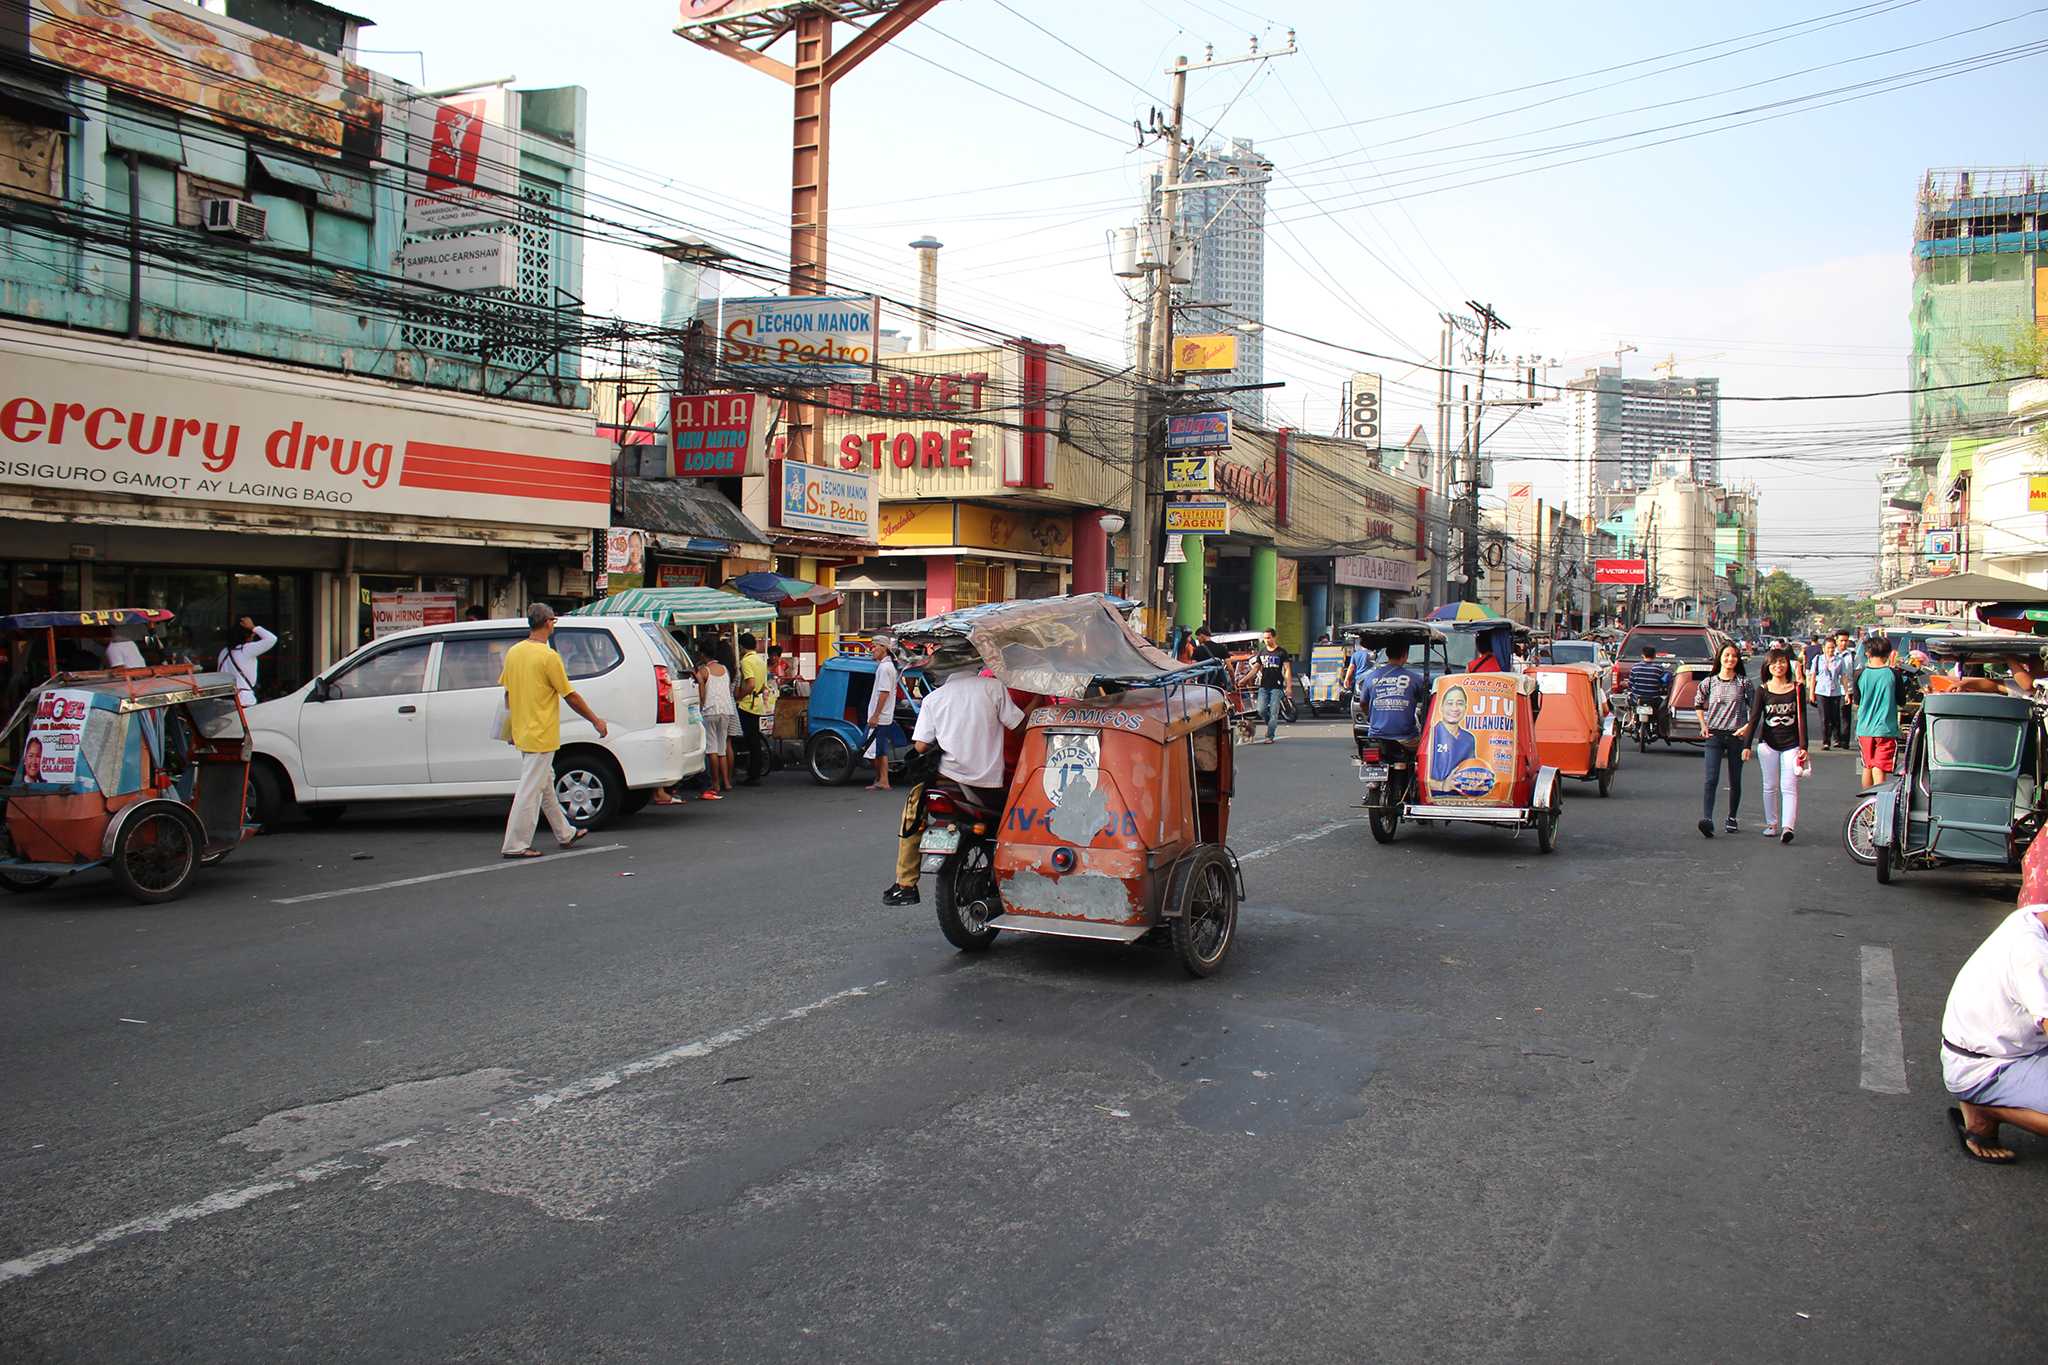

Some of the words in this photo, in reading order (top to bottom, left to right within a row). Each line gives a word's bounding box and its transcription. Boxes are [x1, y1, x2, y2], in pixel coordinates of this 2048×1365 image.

[407, 248, 499, 267] SAMPALOC-EARNSHAW
[756, 313, 813, 333] LECHON
[818, 312, 870, 333] MANOK
[777, 337, 869, 365] Pedro
[827, 371, 989, 416] MARKET
[1353, 391, 1378, 438] 800
[677, 431, 705, 449] NEW
[706, 430, 747, 449] METRO
[839, 428, 974, 470] STORE
[264, 421, 394, 489] drug
[684, 451, 735, 471] LODGE
[112, 470, 192, 491] GAMOT
[196, 478, 223, 493] AY
[228, 481, 298, 500] LAGING
[302, 488, 353, 504] BAGO
[821, 480, 846, 497] LECHON
[846, 485, 868, 500] MANOK
[830, 500, 868, 522] Pedro
[1183, 509, 1225, 519] AUTHORIZED
[1183, 519, 1224, 528] AGENT
[1377, 563, 1383, 577] &
[372, 611, 393, 623] NOW
[395, 609, 424, 622] HIRING!
[1396, 674, 1410, 689] 8
[1061, 707, 1145, 730] AMIGOS
[1465, 715, 1514, 731] VILLANUEVA
[1050, 747, 1094, 768] MIDES
[1437, 743, 1448, 753] 24
